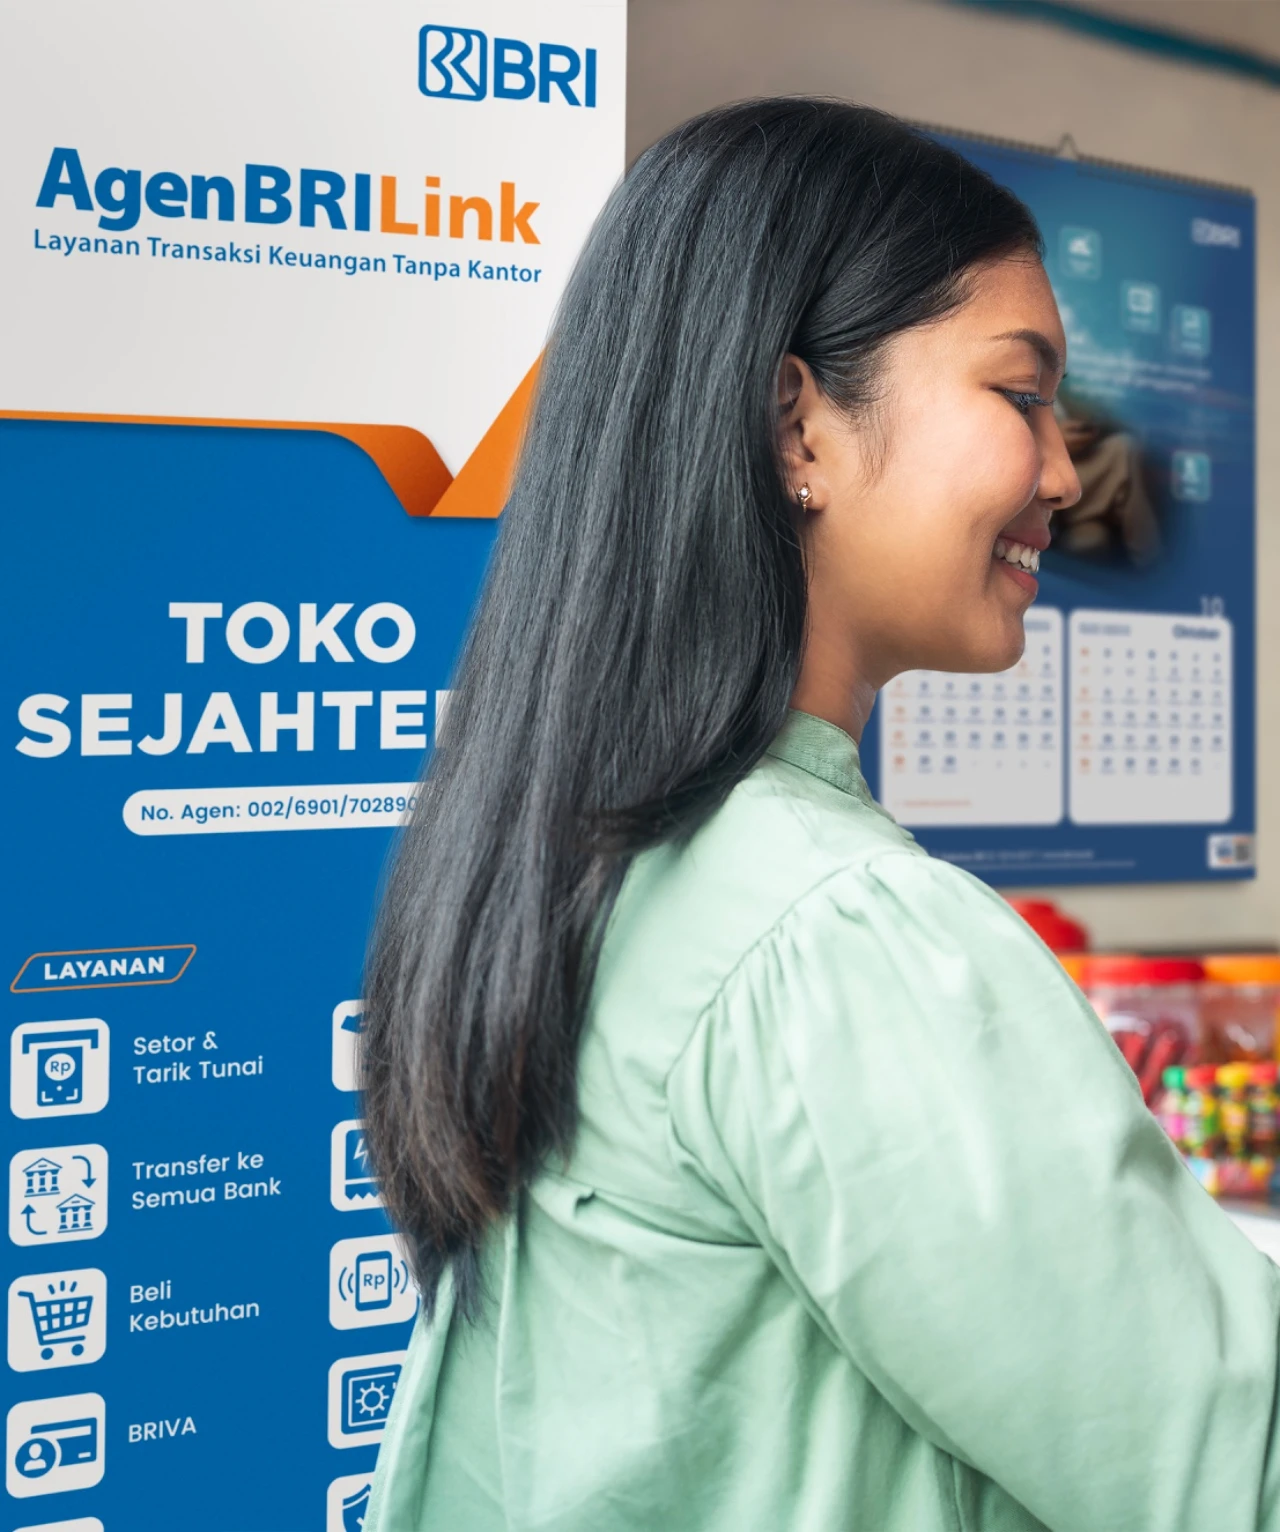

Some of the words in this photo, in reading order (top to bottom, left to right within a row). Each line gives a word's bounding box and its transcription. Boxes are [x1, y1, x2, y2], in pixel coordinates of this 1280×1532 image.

[493, 37, 598, 108] BRI
[35, 146, 542, 245] AgenBRILink
[34, 229, 140, 257] Layanan
[147, 237, 262, 265] Transaksi
[268, 246, 387, 276] Keuangan
[393, 254, 461, 280] Tanpa
[468, 260, 542, 283] Kantor
[168, 601, 416, 664] TOKO
[141, 805, 174, 821] No.
[181, 803, 241, 824] Agen:
[44, 957, 165, 981] LAYANAN
[133, 1035, 196, 1055] Setor
[203, 1031, 218, 1050] &
[50, 1059, 71, 1076] Rp
[133, 1063, 191, 1084] Tarik
[199, 1057, 264, 1079] Tunai
[132, 1156, 230, 1180] Transfer
[237, 1151, 264, 1171] ke
[132, 1186, 216, 1209] Semua
[224, 1178, 281, 1201] Bank
[130, 1281, 172, 1303] Beli
[363, 1273, 385, 1289] Rp
[130, 1301, 260, 1333] Kebutuhan
[128, 1416, 197, 1443] BRIVA
